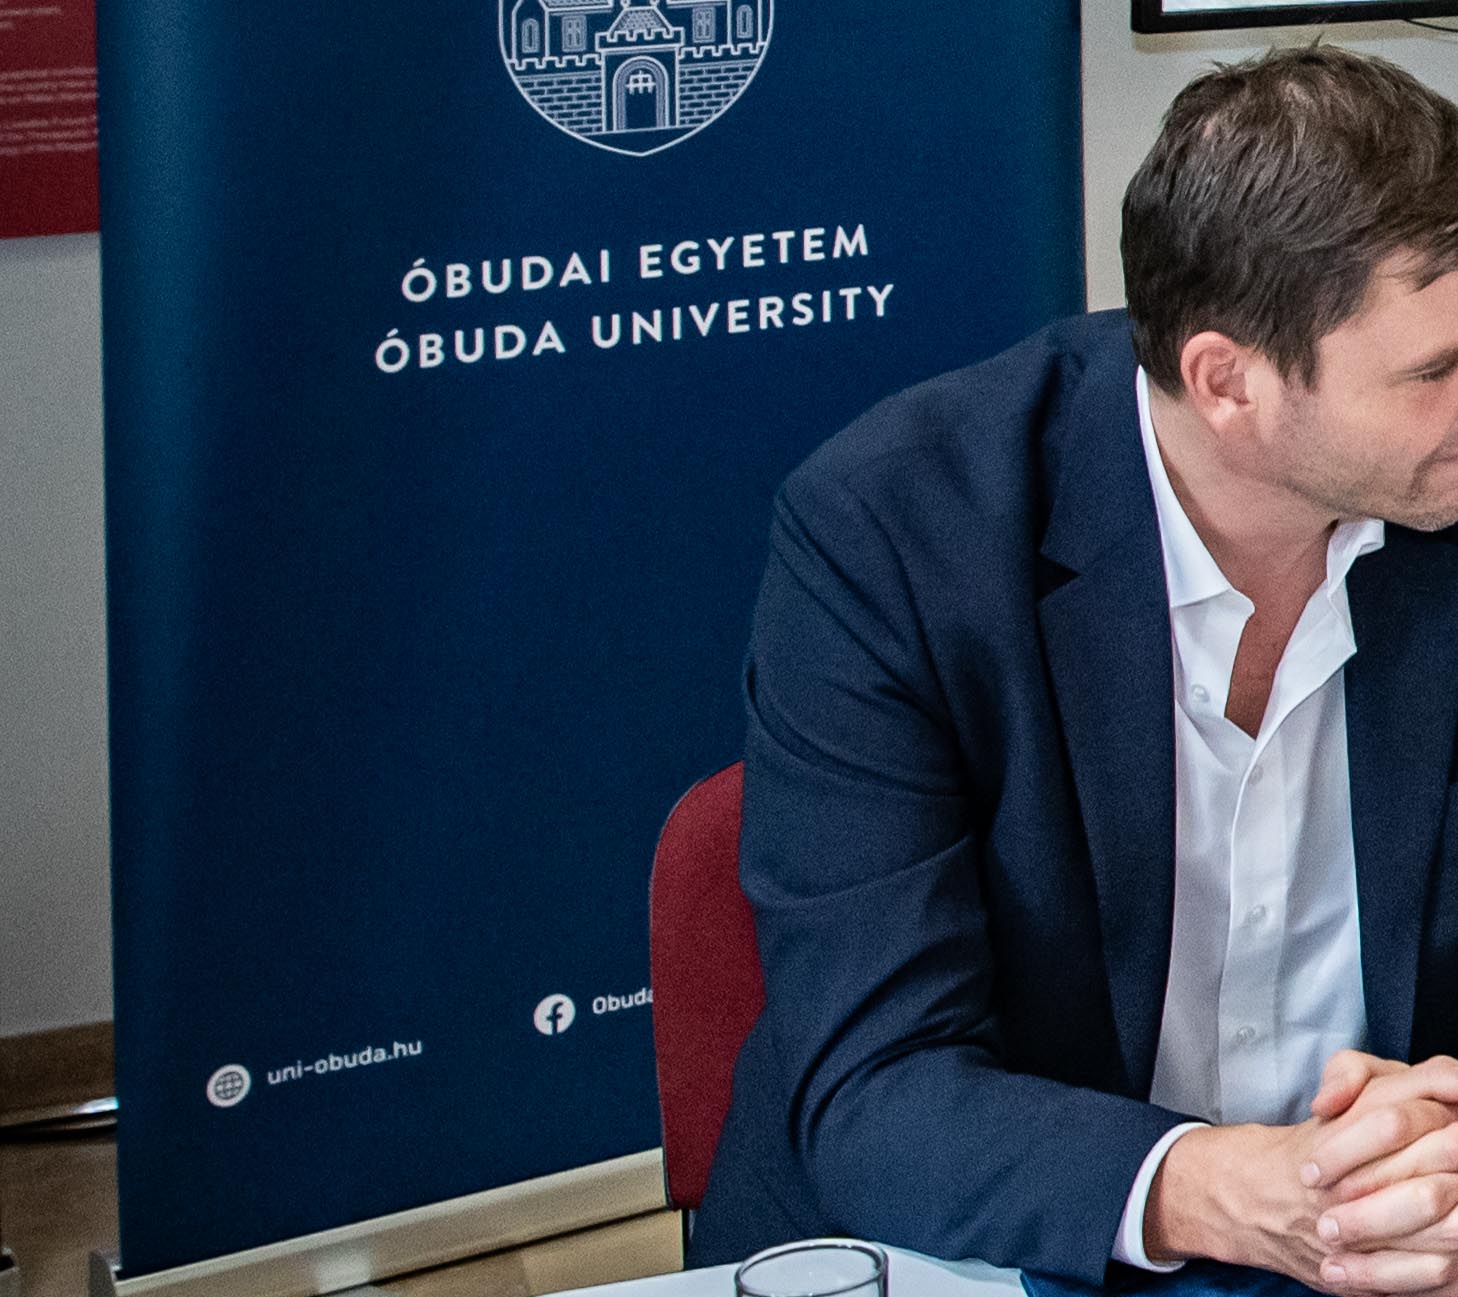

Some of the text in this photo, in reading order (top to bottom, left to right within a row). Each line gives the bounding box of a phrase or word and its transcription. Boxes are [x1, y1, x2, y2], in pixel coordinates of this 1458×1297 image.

[400, 223, 869, 304] ÓBUDAI EGYETEM
[374, 283, 895, 374] ÓBUDA UNIVERSITY
[266, 1037, 423, 1086] uni-obuda.hu
